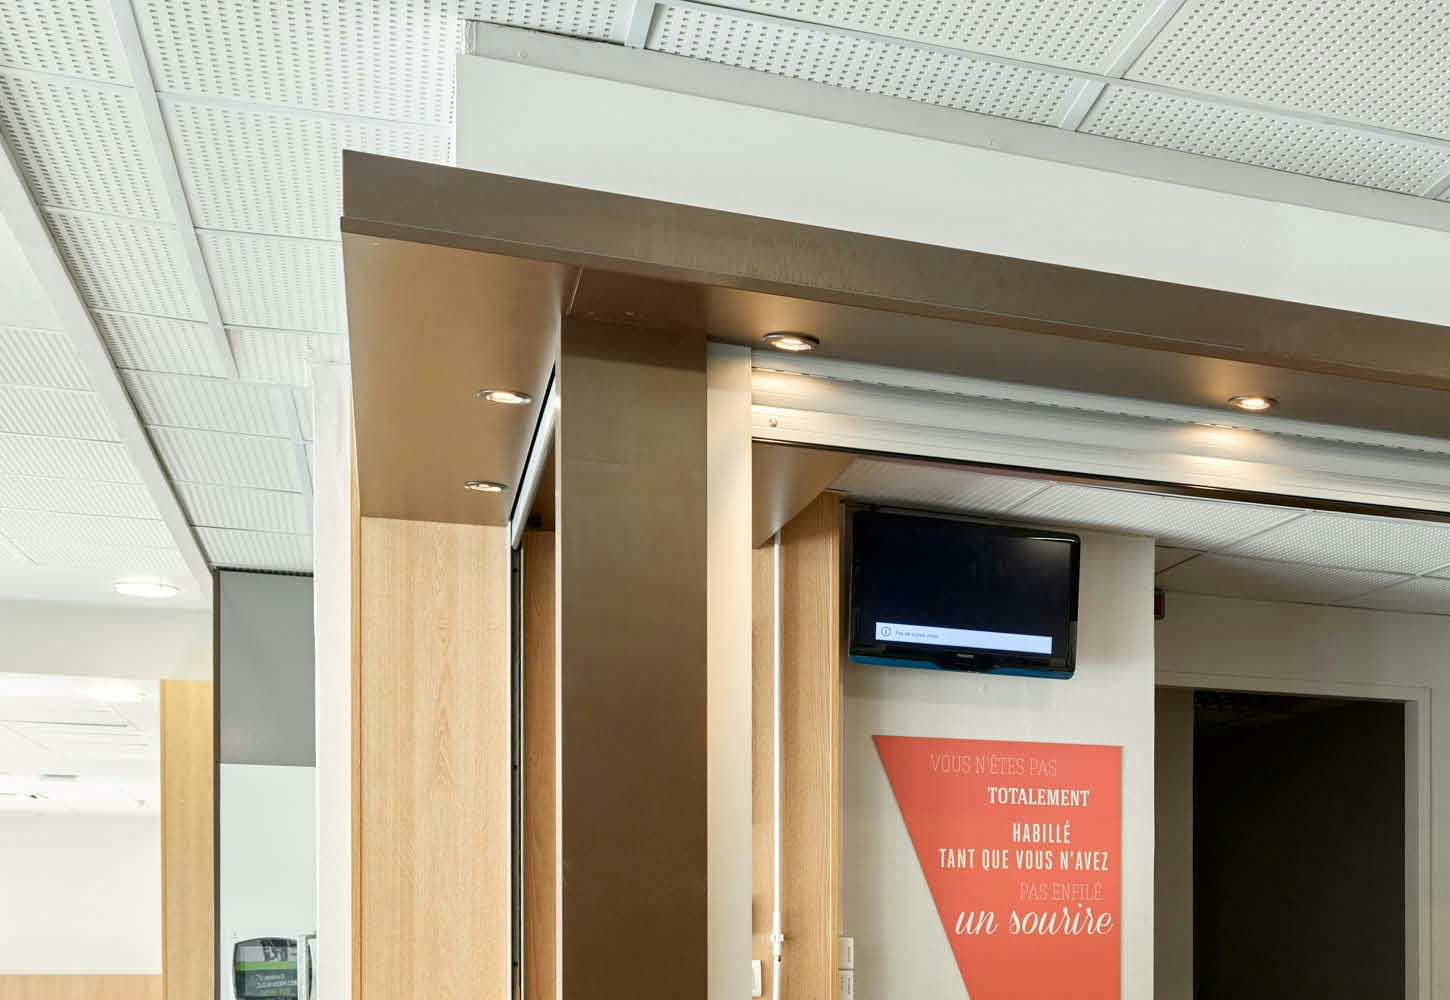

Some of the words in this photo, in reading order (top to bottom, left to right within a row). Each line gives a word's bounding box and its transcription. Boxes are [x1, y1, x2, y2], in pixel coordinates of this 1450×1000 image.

[930, 754, 971, 774] VOUS
[1029, 759, 1057, 776] PAS
[987, 786, 1090, 807] TOTALEMENT
[1012, 820, 1071, 844] HABILLÉ
[939, 848, 976, 869] TANT
[981, 849, 1009, 871] QUE
[1015, 850, 1053, 871] VOUS
[1059, 850, 1109, 871] N'AVEZ
[1019, 882, 1048, 901] PAS
[1053, 881, 1105, 901] ENFILÉ
[955, 909, 999, 935] un
[1008, 903, 1114, 936] sourire
